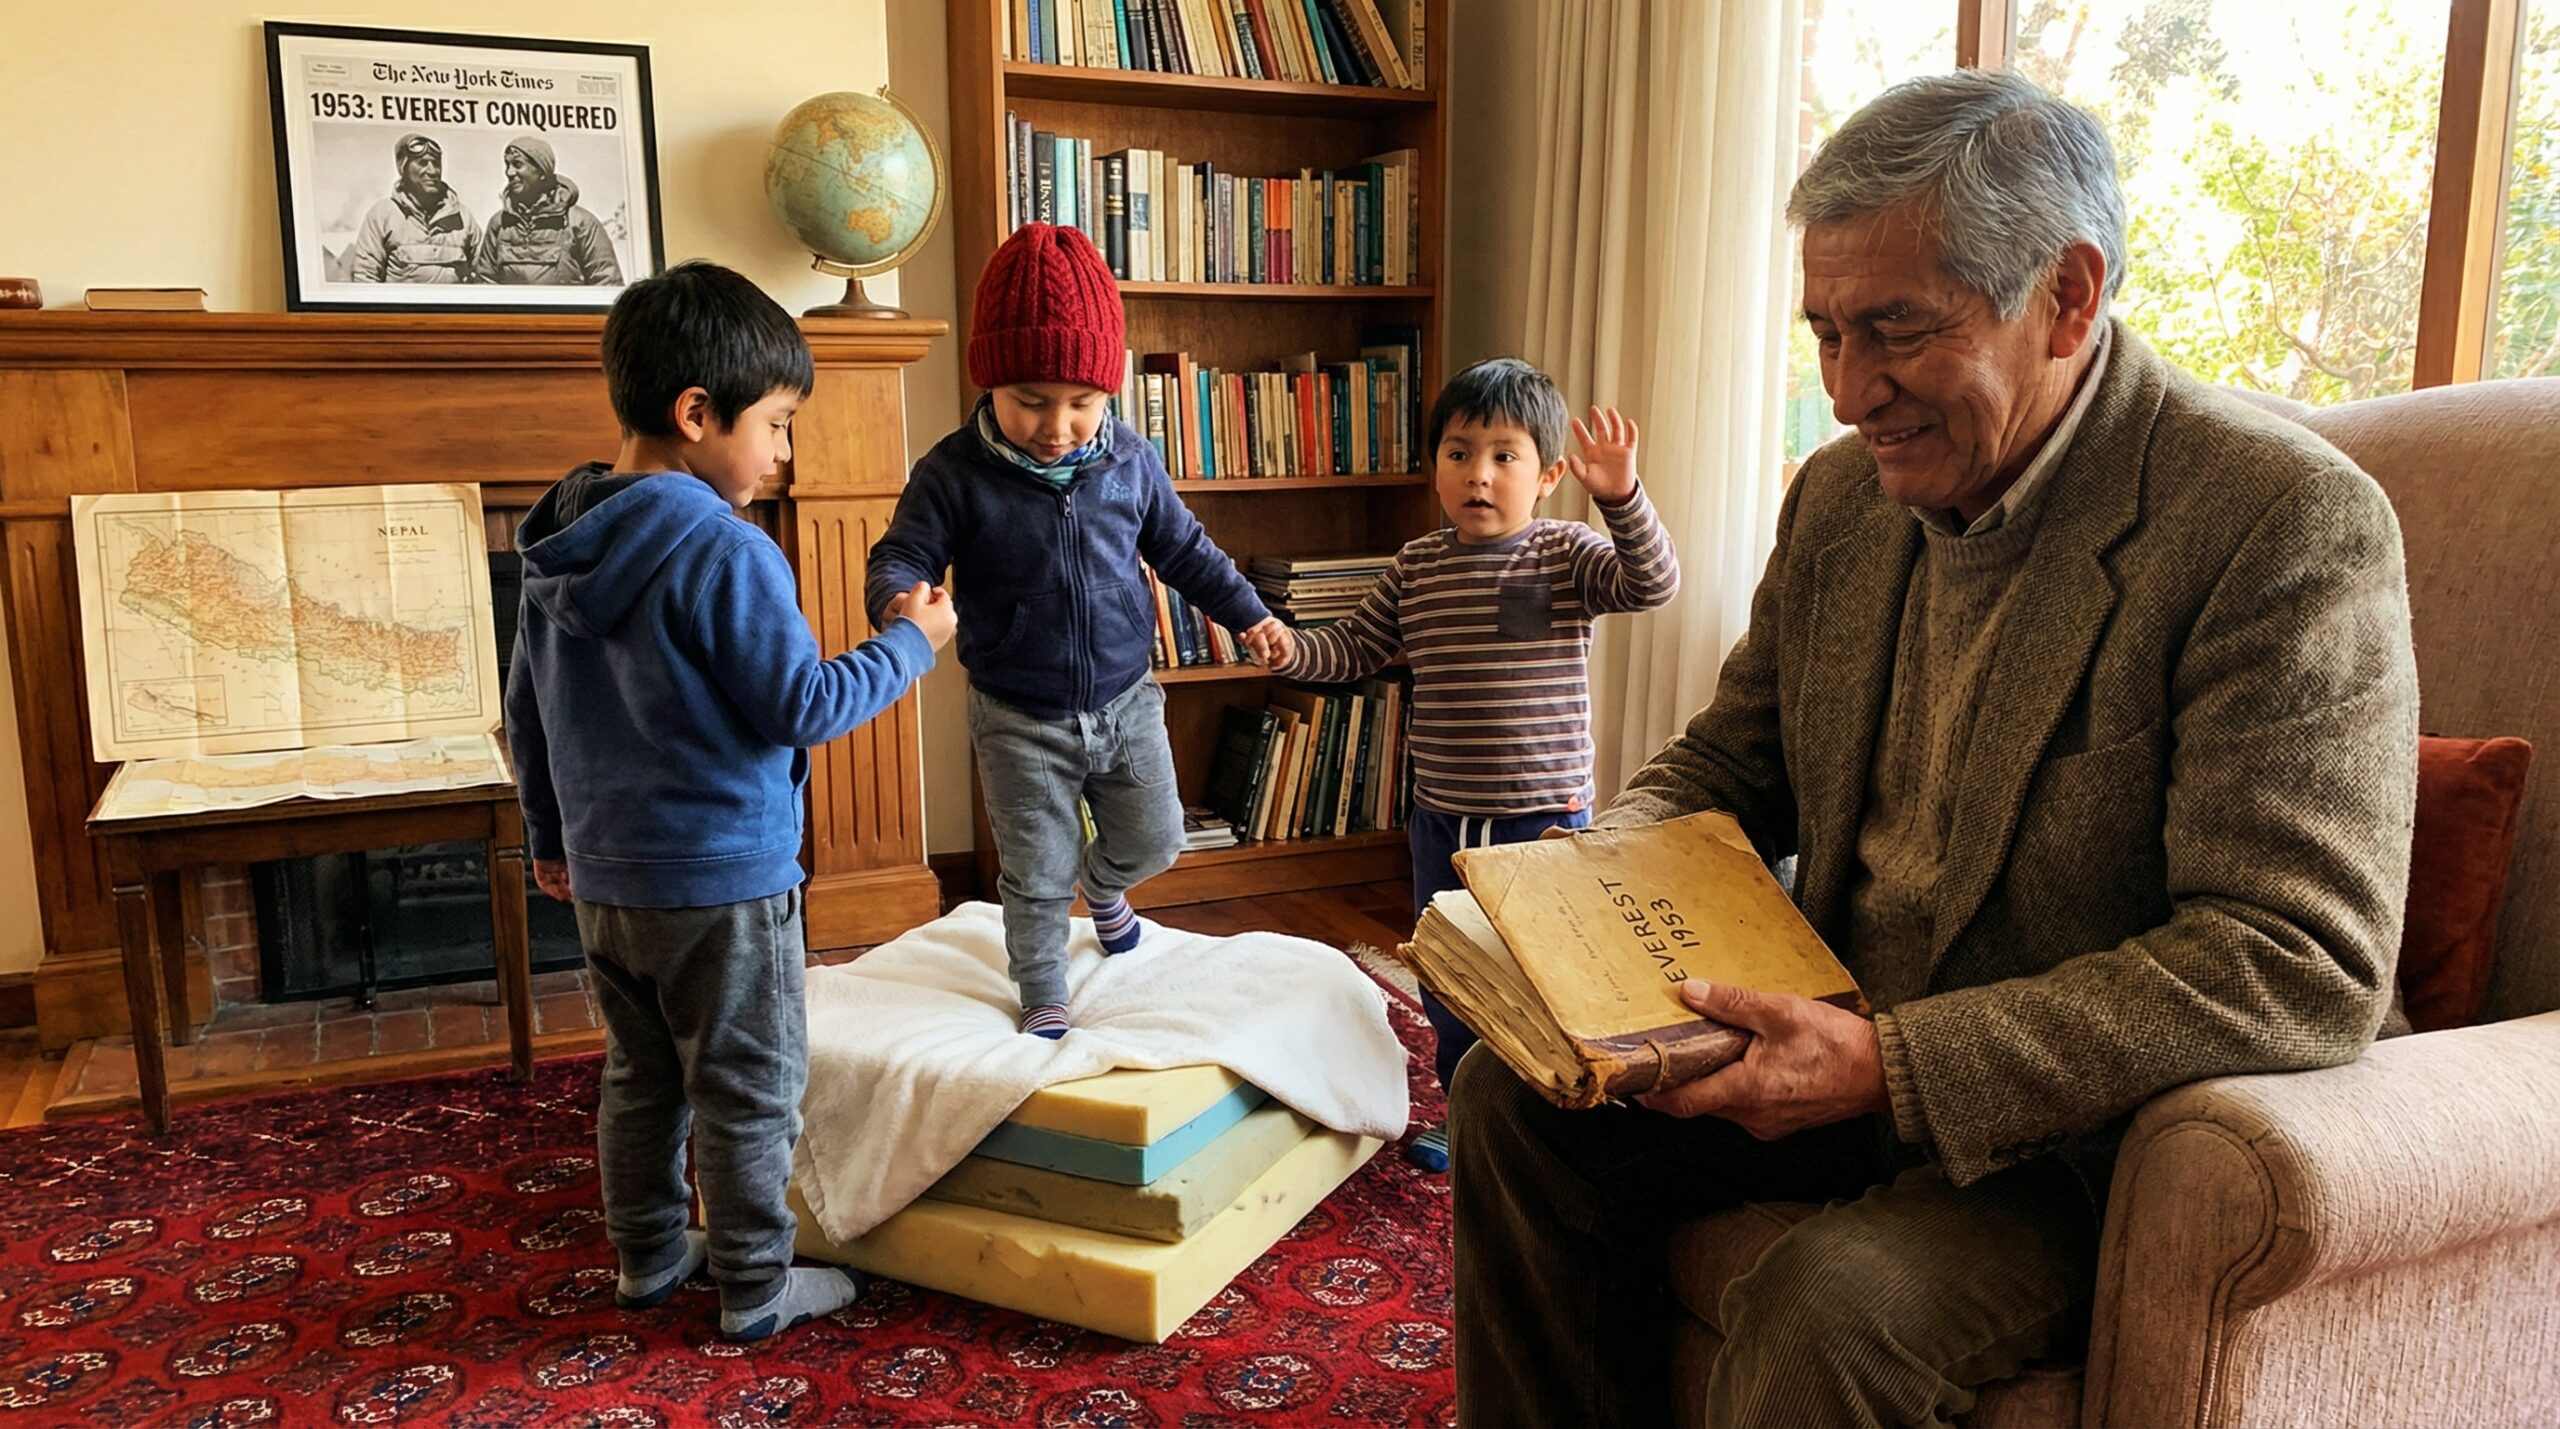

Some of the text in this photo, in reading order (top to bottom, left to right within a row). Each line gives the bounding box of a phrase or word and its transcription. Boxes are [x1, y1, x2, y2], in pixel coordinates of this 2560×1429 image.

[373, 62, 555, 91] The New York Times
[310, 92, 617, 132] 1953: EVEREST CONQUERED
[377, 525, 429, 538] NEPAL
[1598, 878, 1689, 984] EVEREST
[1650, 898, 1701, 948] 1953
